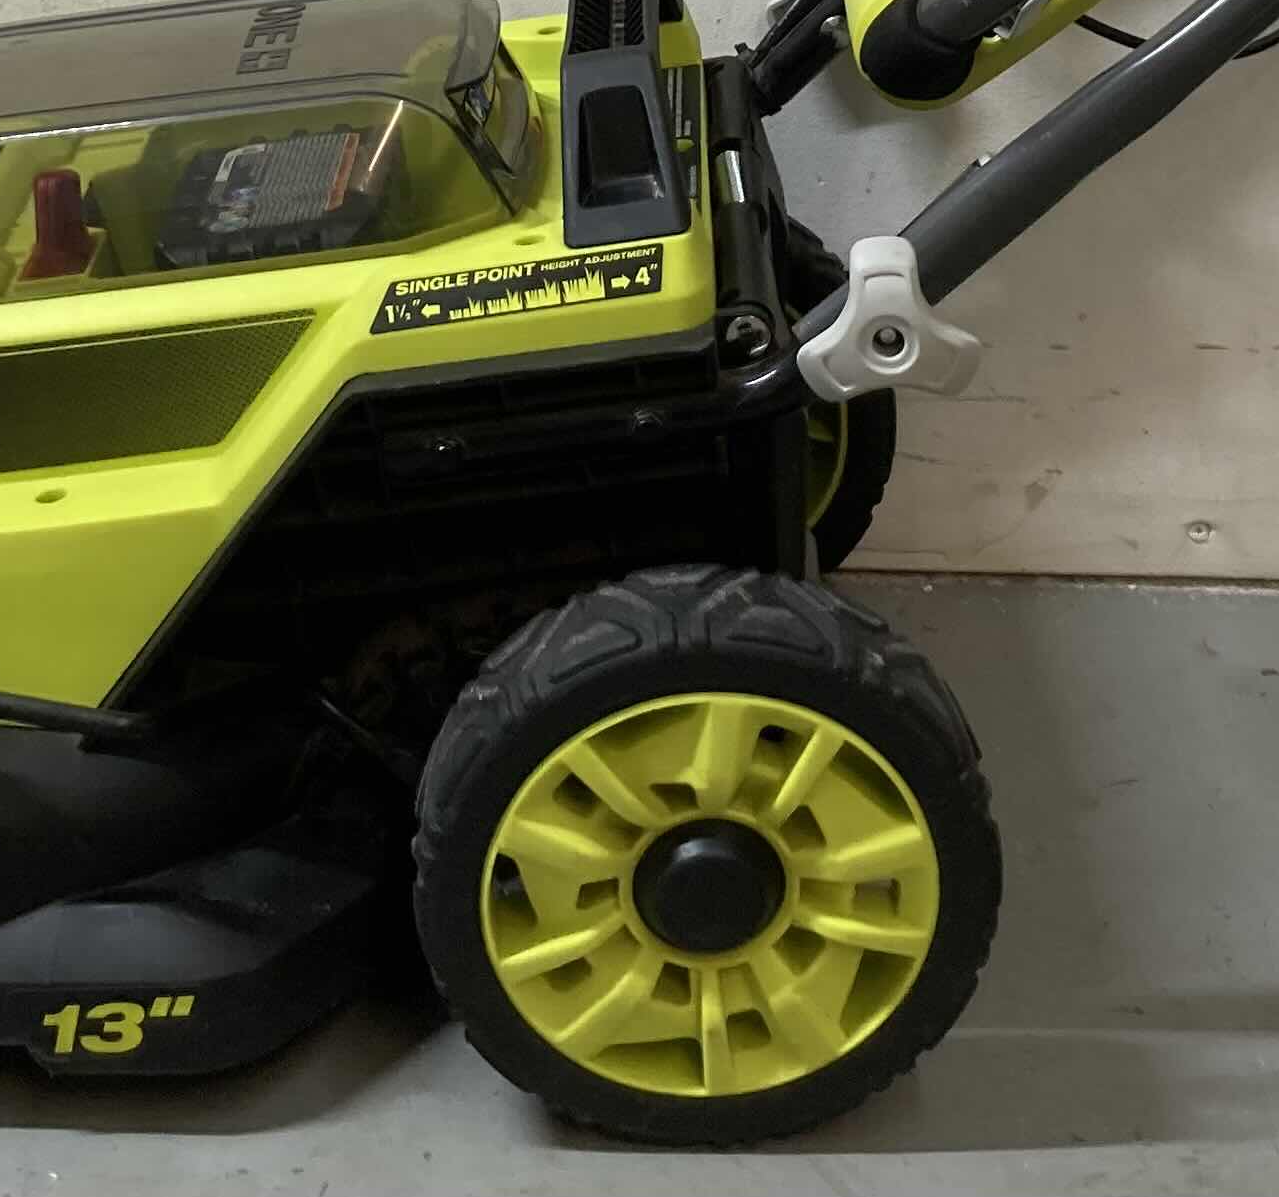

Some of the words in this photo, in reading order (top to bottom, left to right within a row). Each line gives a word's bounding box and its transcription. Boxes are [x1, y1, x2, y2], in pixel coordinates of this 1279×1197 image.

[395, 272, 470, 296] SINGLE
[473, 262, 537, 284] POINT
[540, 258, 581, 272] HEIGHT
[584, 247, 657, 265] ADJUSTMENT
[634, 263, 658, 286] 4"
[42, 995, 196, 1054] 13"
